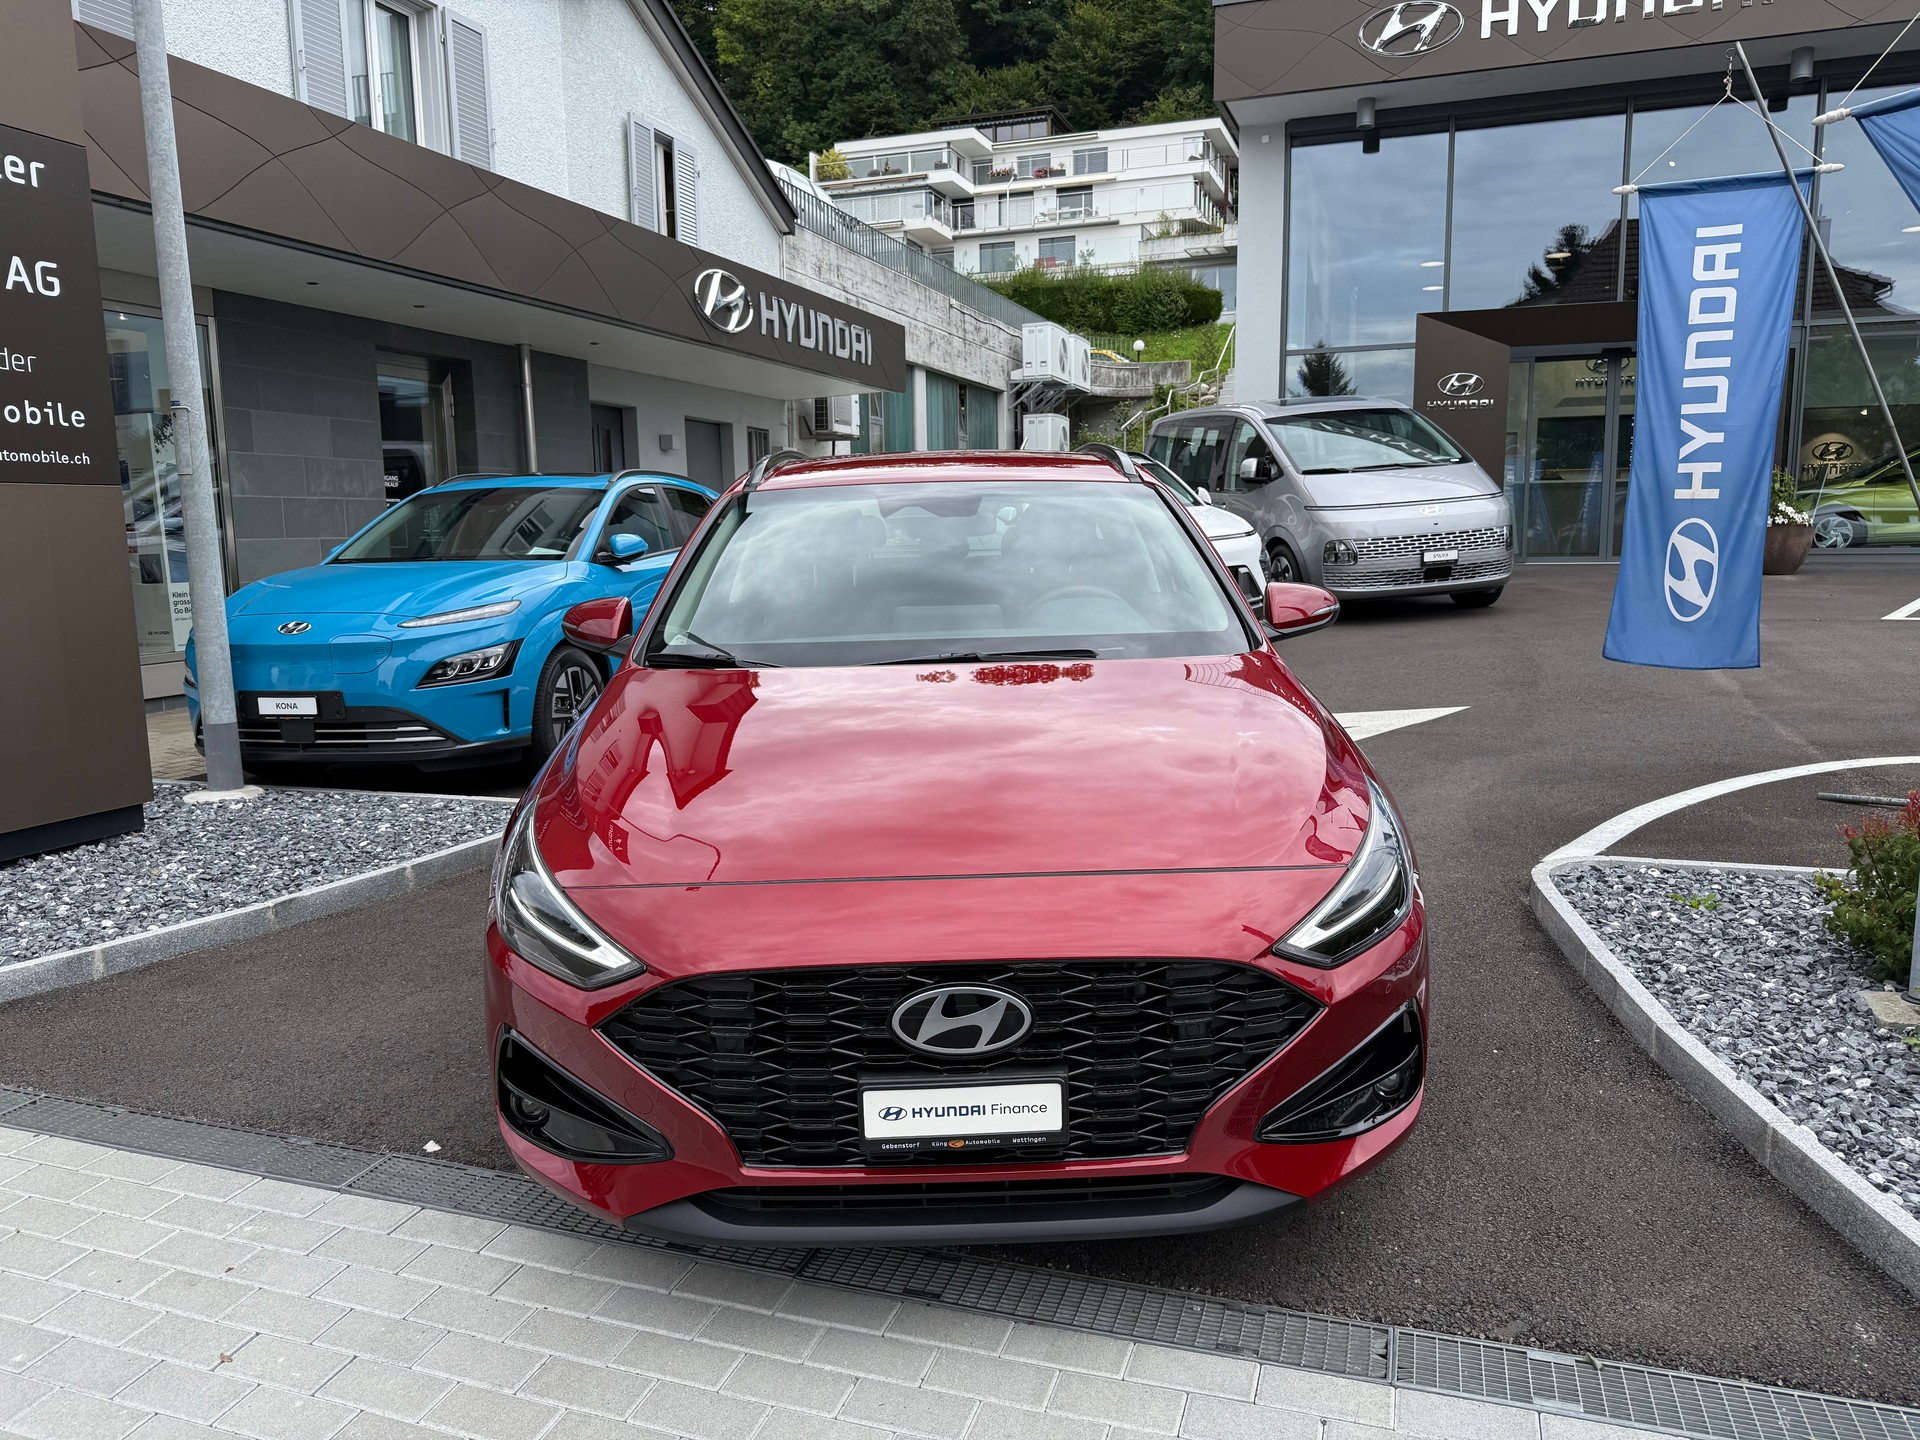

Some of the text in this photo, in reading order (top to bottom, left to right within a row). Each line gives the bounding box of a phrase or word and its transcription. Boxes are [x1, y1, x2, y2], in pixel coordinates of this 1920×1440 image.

[0, 154, 45, 188] er
[5, 255, 61, 297] AG
[759, 291, 872, 366] HYUNDAI
[1673, 223, 1744, 499] HYUNDAI
[3, 400, 86, 428] obile
[275, 702, 298, 710] KONA
[912, 1102, 1048, 1119] HYUNDAI Finance
[881, 1142, 920, 1150] Gebenstorf
[1012, 1136, 1047, 1144] Wettingen
